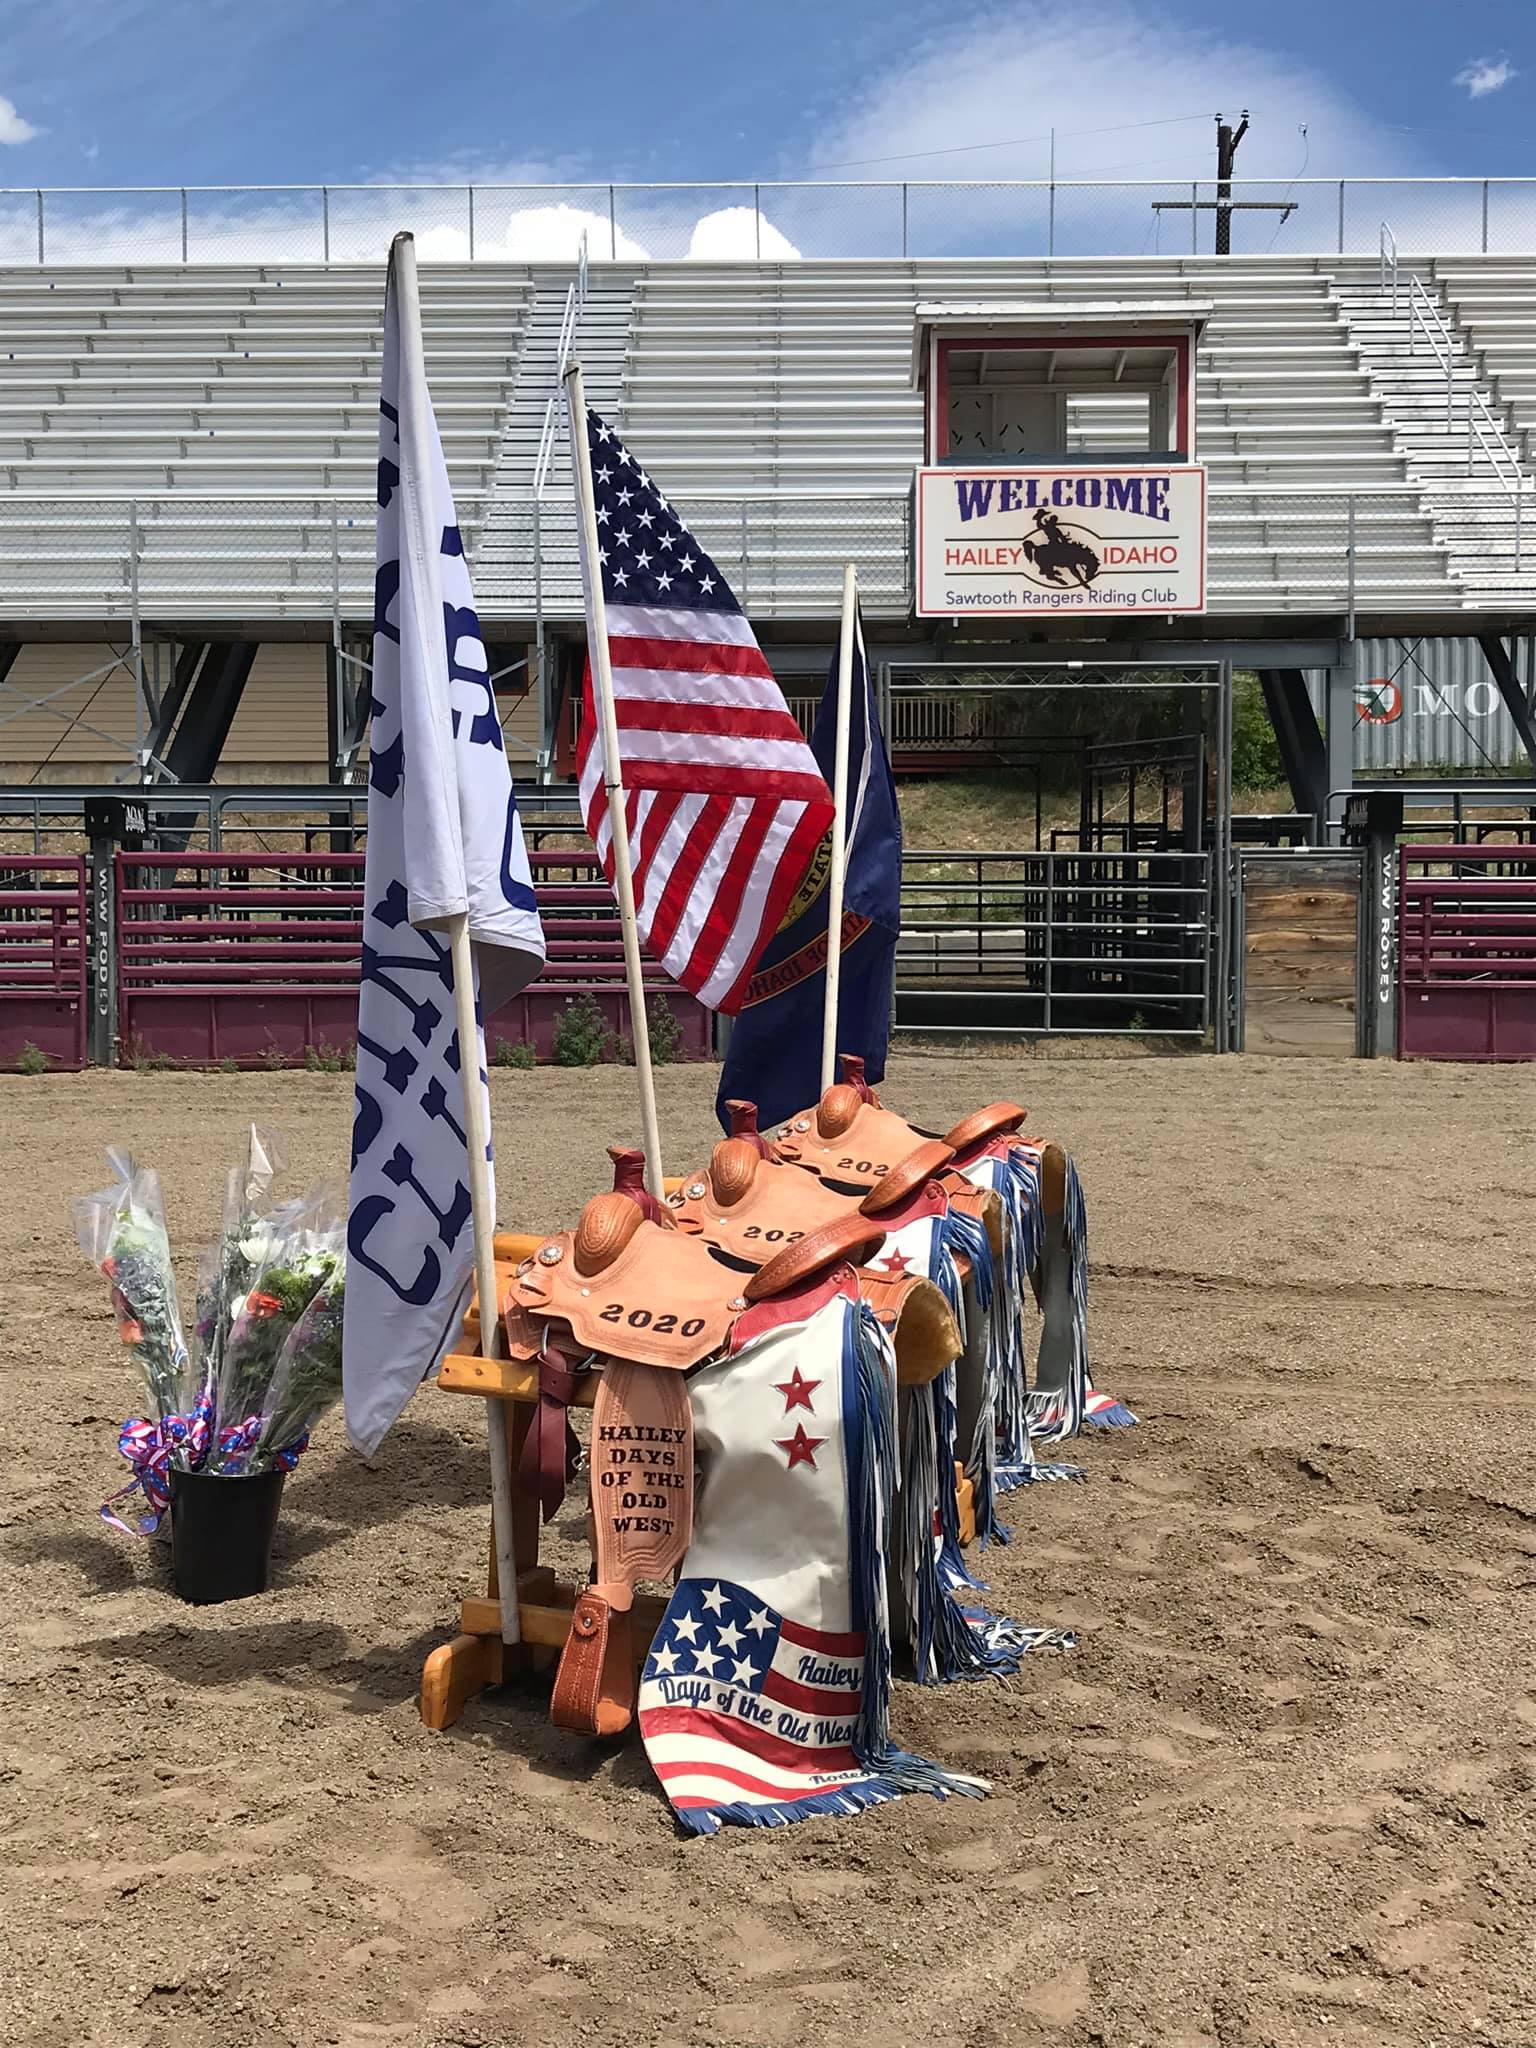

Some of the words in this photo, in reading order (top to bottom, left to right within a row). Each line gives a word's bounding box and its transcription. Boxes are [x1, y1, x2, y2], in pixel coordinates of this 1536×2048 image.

[954, 478, 1170, 522] WELCOME
[945, 547, 1022, 565] HAILEY
[1103, 546, 1178, 564] IDAHO
[945, 590, 1017, 605] Sawtooth
[1023, 590, 1083, 607] Rangers
[1089, 588, 1136, 606] Riding
[1142, 587, 1178, 604] Club
[1382, 853, 1392, 910] W-W
[99, 867, 108, 922] W-W
[837, 1157, 890, 1177] 202
[743, 1226, 806, 1243] 202
[599, 1303, 706, 1337] 2020
[599, 1425, 686, 1444] HAILEY
[609, 1448, 675, 1466] DAYS
[600, 1471, 632, 1487] OF
[643, 1472, 684, 1489] THE
[622, 1492, 667, 1509] OLD
[613, 1516, 674, 1536] WEST
[798, 1655, 861, 1690] Hailey
[659, 1677, 712, 1709] Days
[716, 1689, 738, 1713] of
[738, 1695, 773, 1724] the
[778, 1713, 811, 1742] Old
